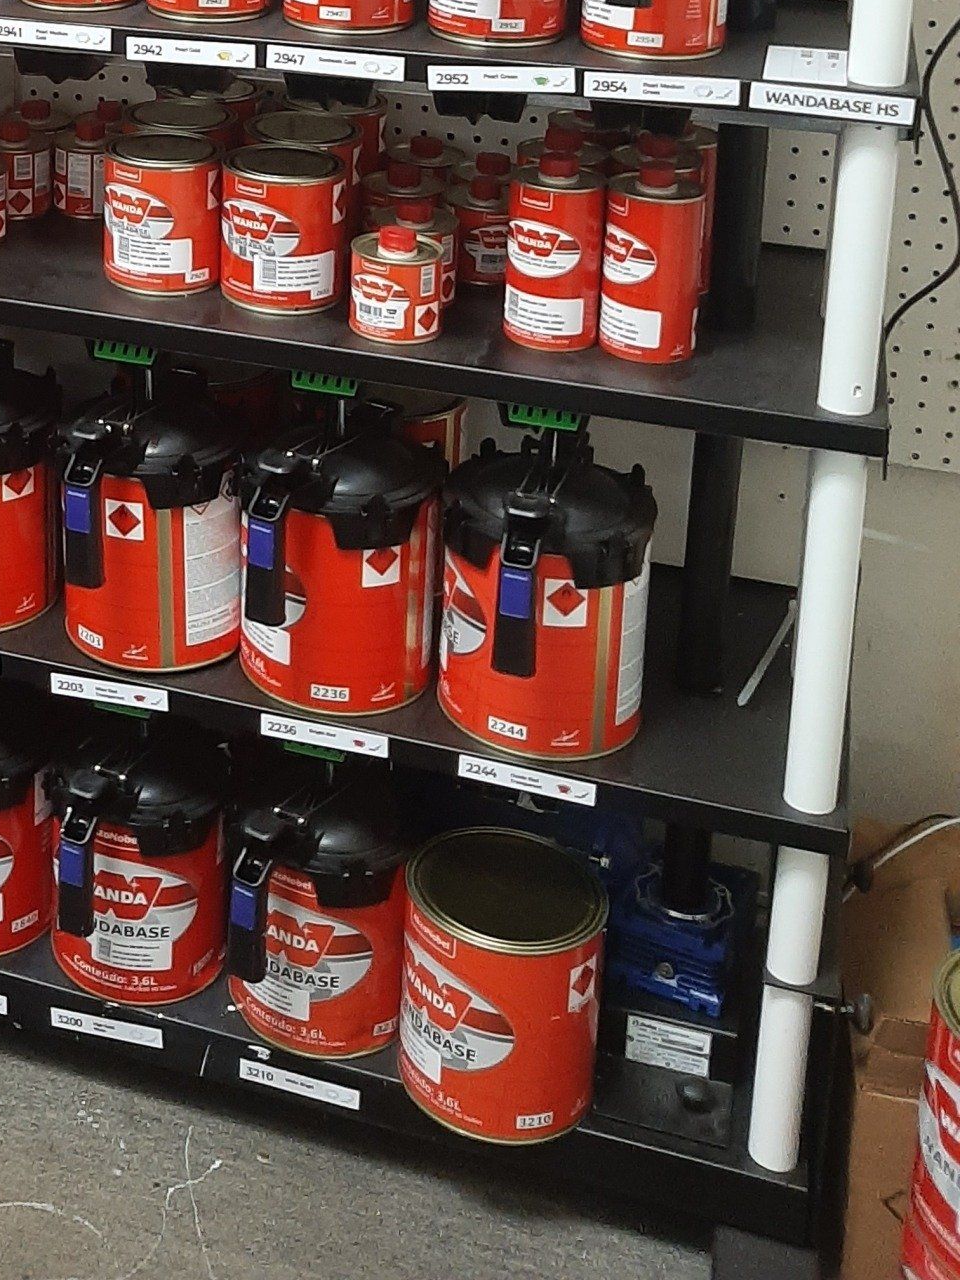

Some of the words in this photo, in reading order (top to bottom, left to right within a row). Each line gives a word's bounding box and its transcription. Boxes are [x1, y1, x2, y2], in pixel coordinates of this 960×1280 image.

[133, 43, 162, 56] 2942
[274, 52, 305, 65] 2947
[436, 73, 469, 85] 2952
[592, 80, 627, 93] 2954
[765, 89, 872, 116] WANDABASE
[876, 103, 899, 117] HS
[113, 199, 143, 216] WANDA
[234, 216, 269, 232] WANDA
[516, 232, 552, 250] WANDA
[80, 629, 102, 647] 2203
[57, 679, 84, 693] 2203
[312, 686, 347, 699] 2236
[267, 721, 297, 736] 2236
[490, 720, 525, 737] 2244
[465, 761, 497, 779] 2244
[97, 918, 171, 939] DABASE
[267, 924, 320, 954] ANDA
[269, 960, 340, 989] DABASE
[406, 962, 457, 1019] WANDA
[246, 1065, 275, 1083] 3210
[519, 1114, 553, 1128] 3210
